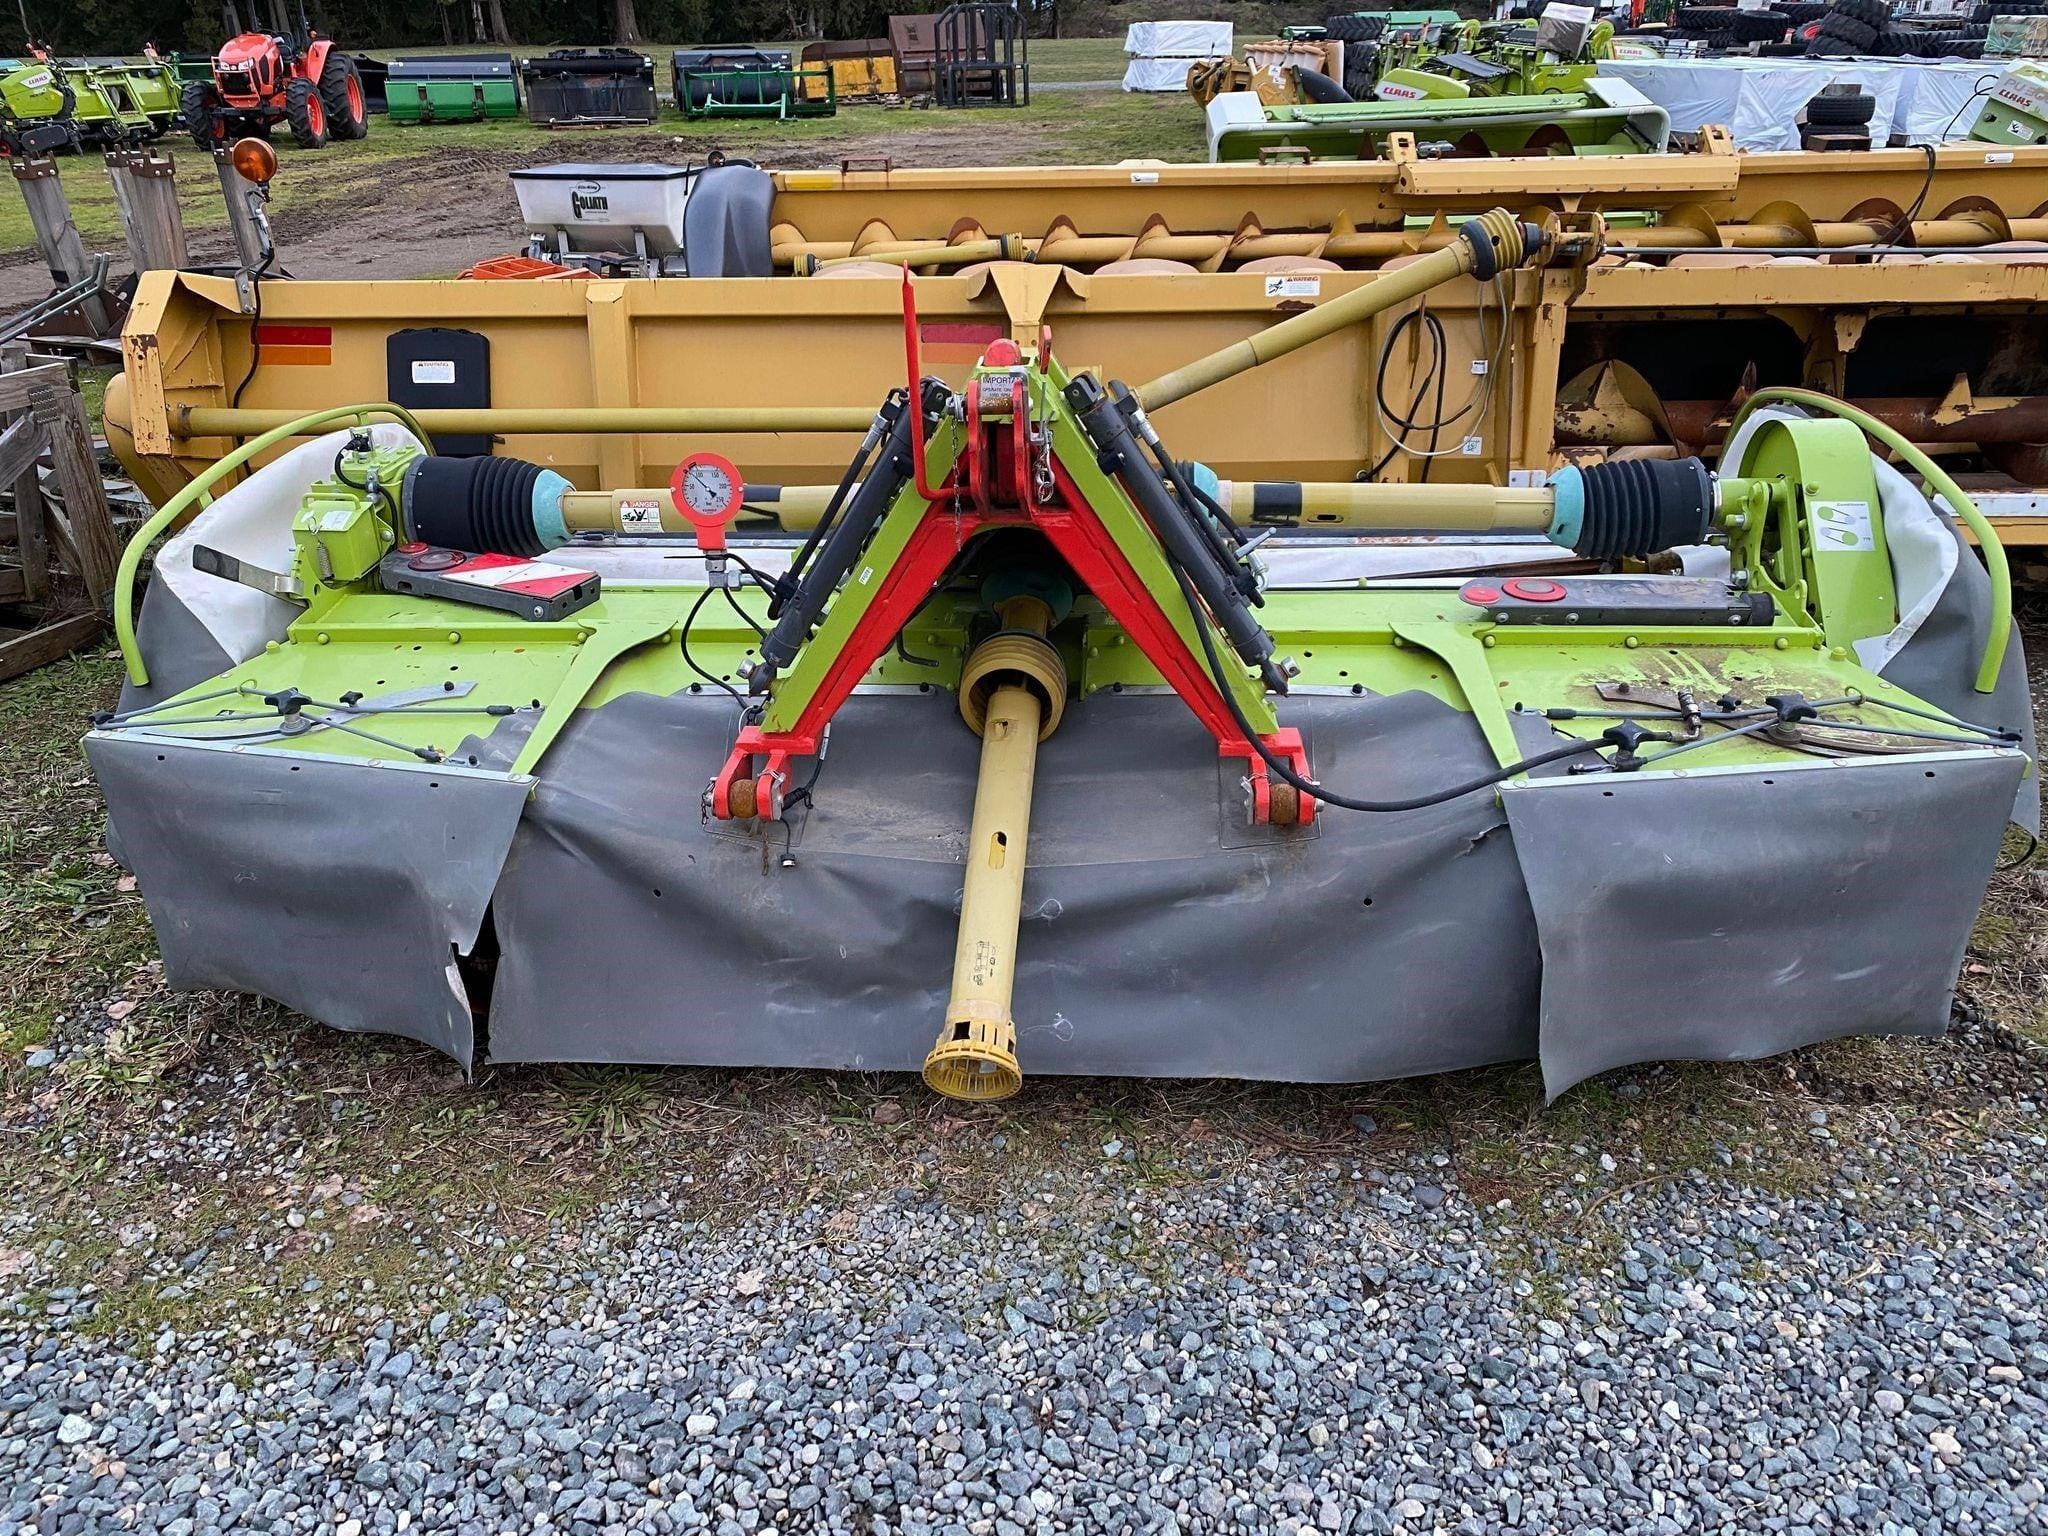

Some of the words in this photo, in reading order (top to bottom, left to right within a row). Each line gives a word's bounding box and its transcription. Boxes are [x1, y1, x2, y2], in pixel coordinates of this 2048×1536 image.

[1382, 87, 1417, 99] CLAAS
[1998, 88, 2033, 107] CLAAS
[571, 191, 608, 219] GOLIATH
